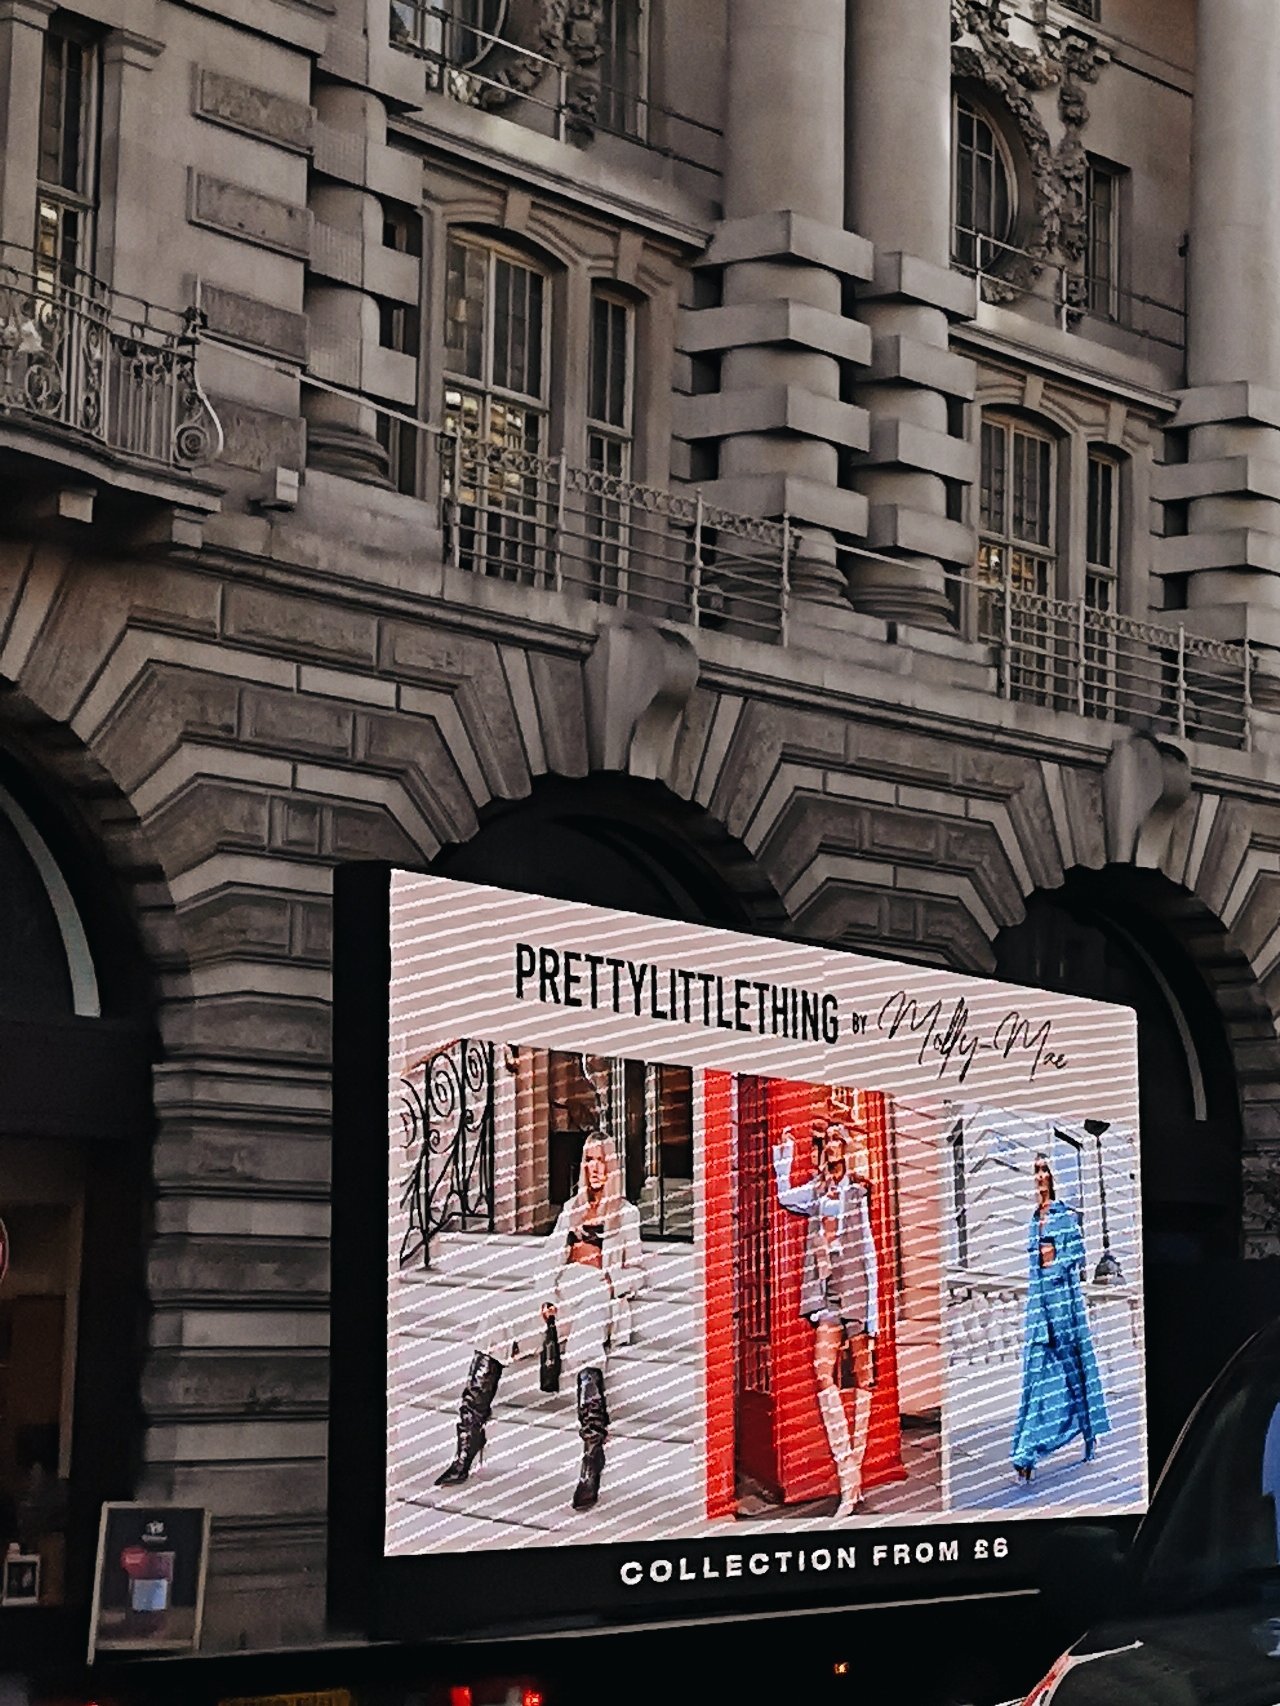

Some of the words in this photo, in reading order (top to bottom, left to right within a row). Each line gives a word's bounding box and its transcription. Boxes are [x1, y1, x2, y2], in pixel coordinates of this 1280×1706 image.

[515, 943, 839, 1045] PRETTYLITTLETHING
[852, 1012, 868, 1034] BY
[877, 991, 1068, 1083] Molly-Mae
[620, 1546, 857, 1586] COLLECTION
[872, 1539, 960, 1566] FROM
[974, 1537, 1010, 1559] £6
